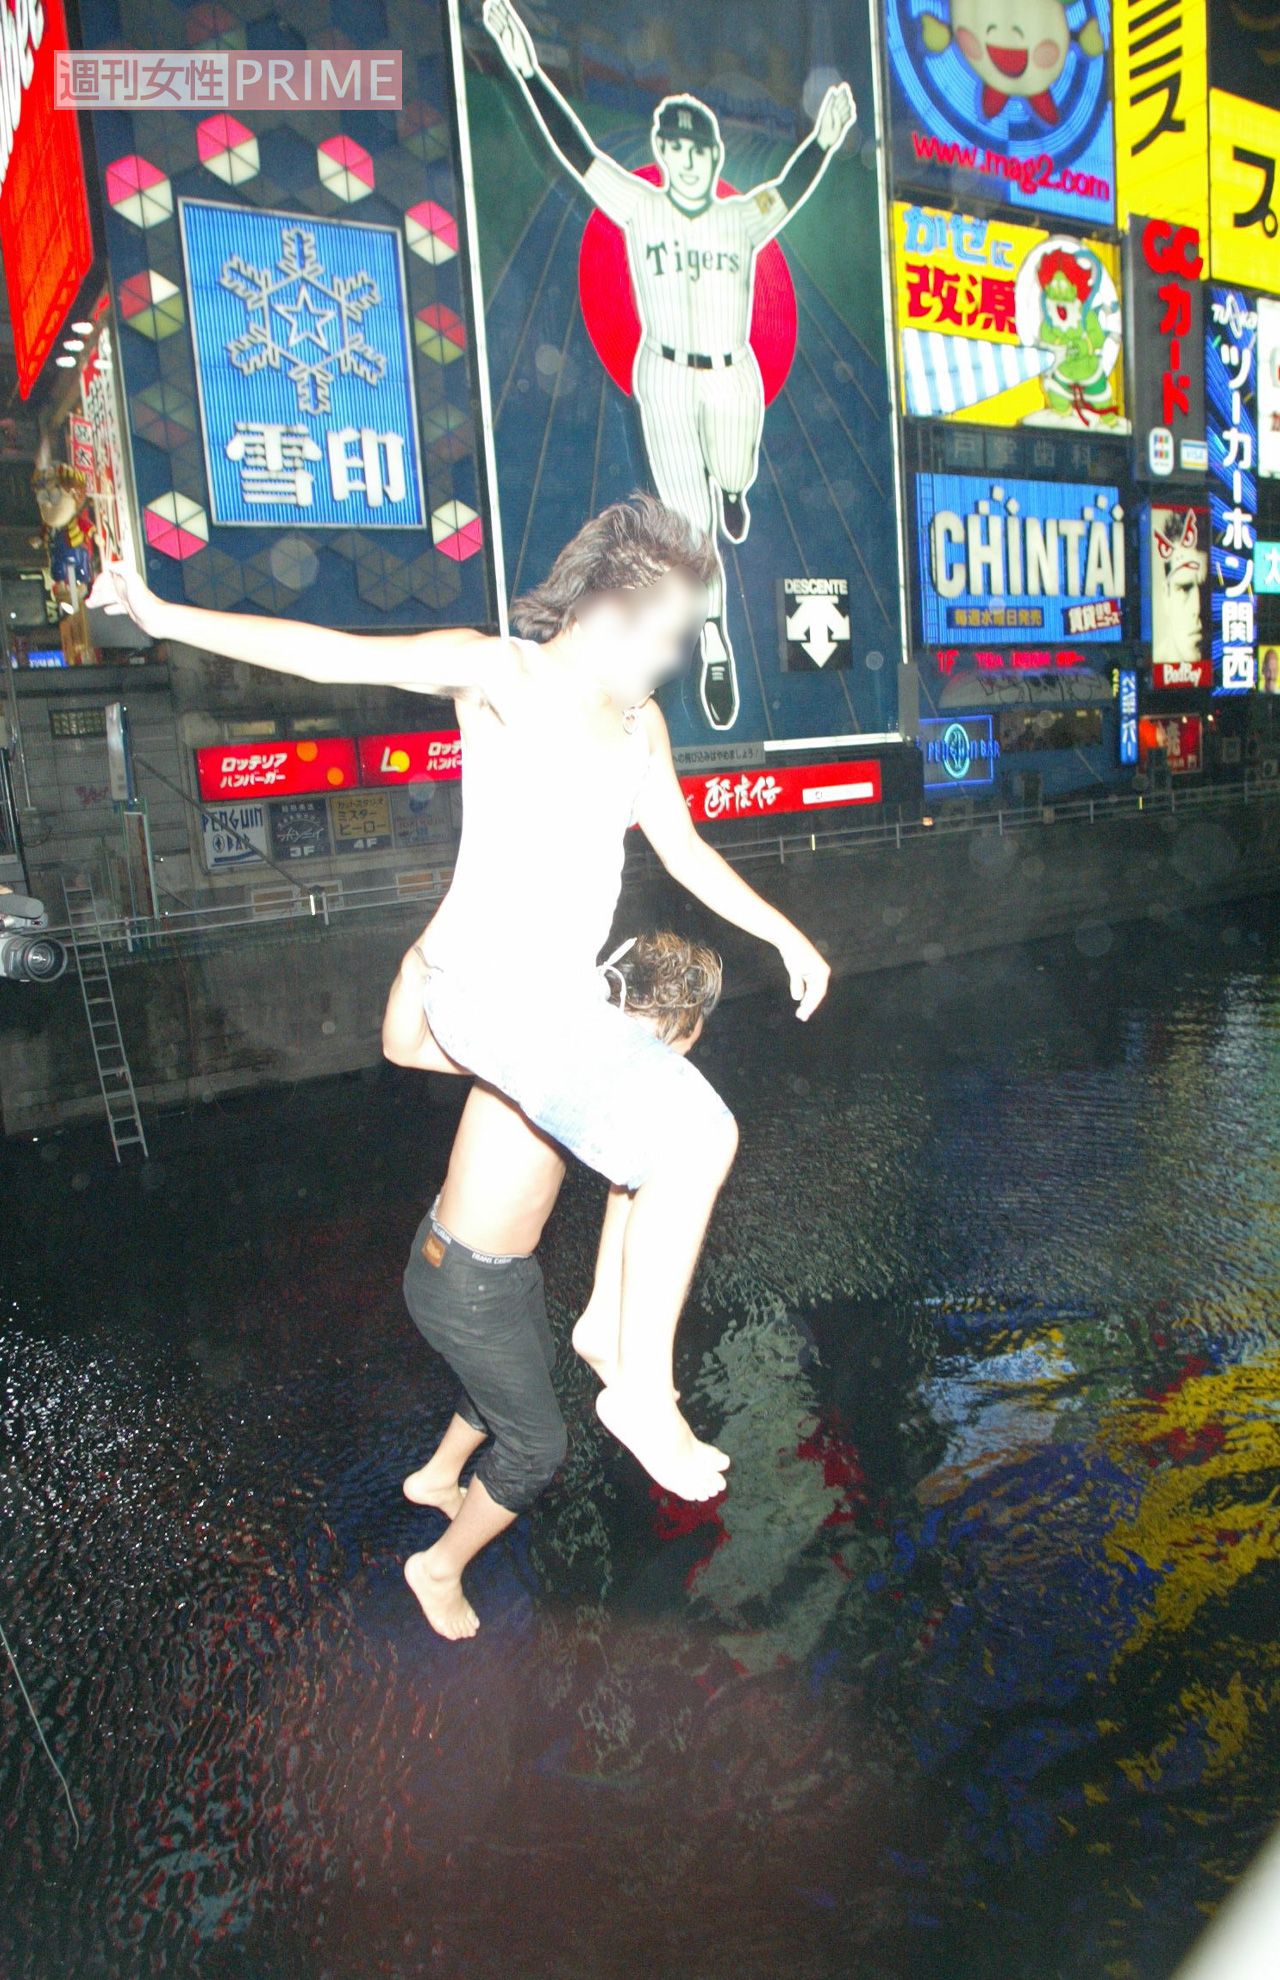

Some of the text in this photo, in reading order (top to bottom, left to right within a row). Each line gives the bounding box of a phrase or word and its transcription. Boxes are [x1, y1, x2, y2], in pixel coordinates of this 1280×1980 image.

[1128, 0, 1186, 158] ミス
[911, 130, 1110, 201] www.mag2.com
[903, 205, 1015, 271] かぜに
[646, 239, 740, 282] Tigers
[905, 261, 1018, 335] 改源
[226, 422, 405, 508] 雪印
[1220, 344, 1254, 690] ツーカーホン関西
[930, 488, 1126, 599] CHINTAI
[784, 578, 848, 595] DESCENTE
[220, 768, 286, 789] ハンバーガー
[221, 752, 288, 773] ロッテリア
[202, 808, 263, 832] PENGUIN
[338, 809, 377, 821] ミスター
[340, 820, 386, 836] ヒーロー
[290, 845, 315, 857] 3F
[353, 837, 377, 849] 4F
